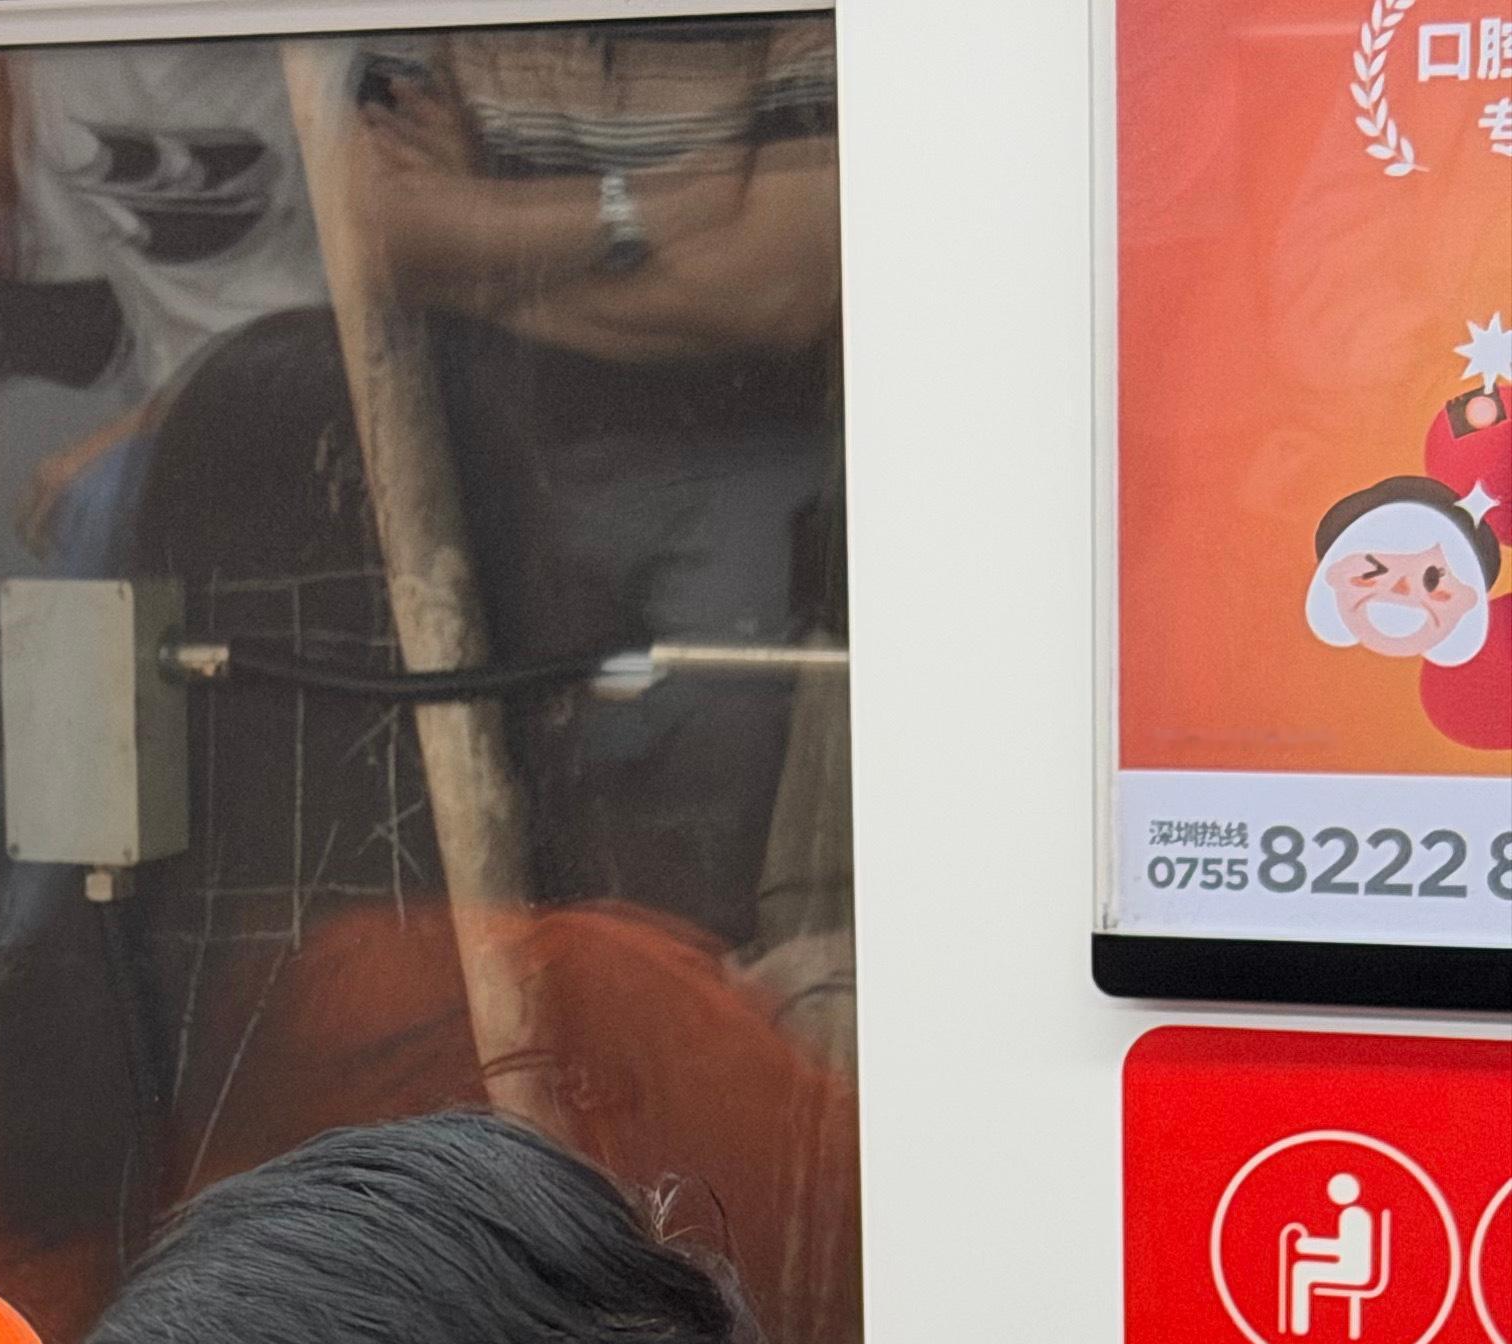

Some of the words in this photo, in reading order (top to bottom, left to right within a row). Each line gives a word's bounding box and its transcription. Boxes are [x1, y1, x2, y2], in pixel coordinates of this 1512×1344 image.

[1149, 819, 1250, 850] 深圳热线
[1147, 856, 1250, 891] 0755
